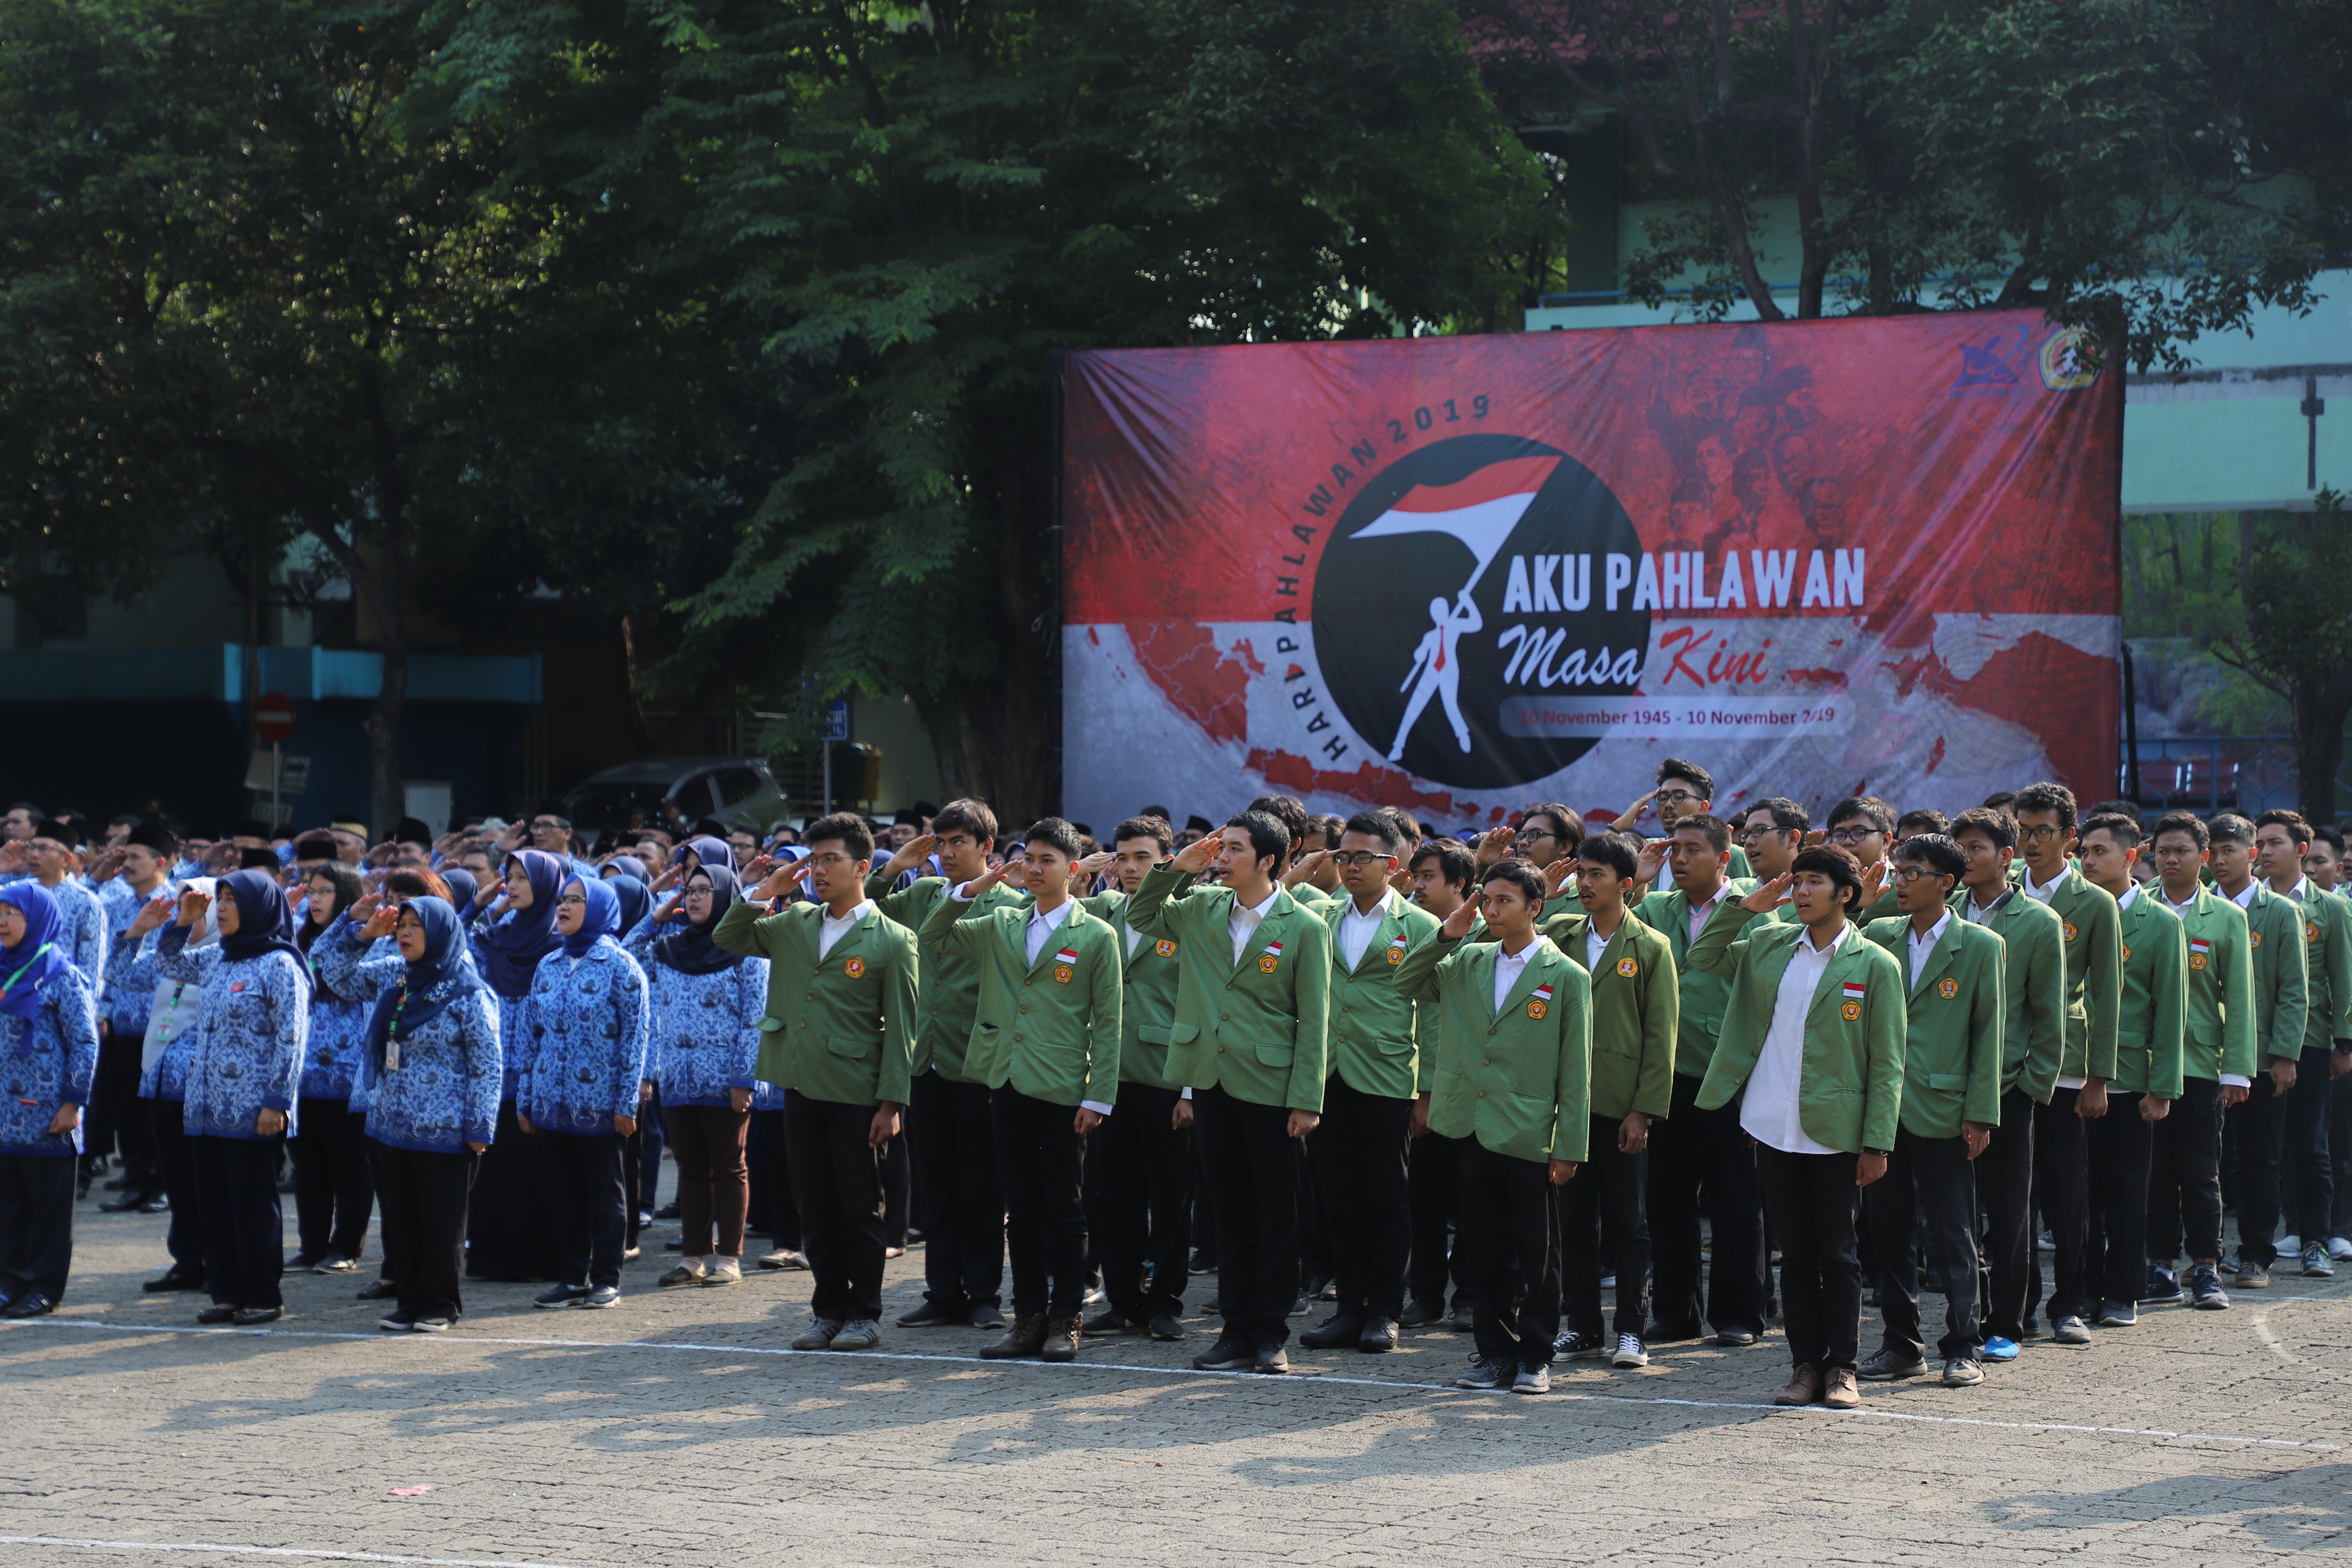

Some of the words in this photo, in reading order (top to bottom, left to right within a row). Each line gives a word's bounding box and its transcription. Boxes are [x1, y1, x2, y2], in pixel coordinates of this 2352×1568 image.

[1386, 394, 1489, 443] 2019
[1274, 438, 1377, 653] PAHLAWAN
[1502, 553, 1591, 613] AKU
[1605, 548, 1865, 611] PAHLAWAN
[1498, 623, 1642, 688] Masa
[1659, 626, 1771, 688] Kini
[1284, 670, 1348, 761] HARI
[1521, 710, 1539, 724] 10
[1544, 709, 1628, 724] November
[1634, 710, 1670, 724] 1945
[1688, 710, 1706, 724] 10
[1711, 710, 1796, 724] November
